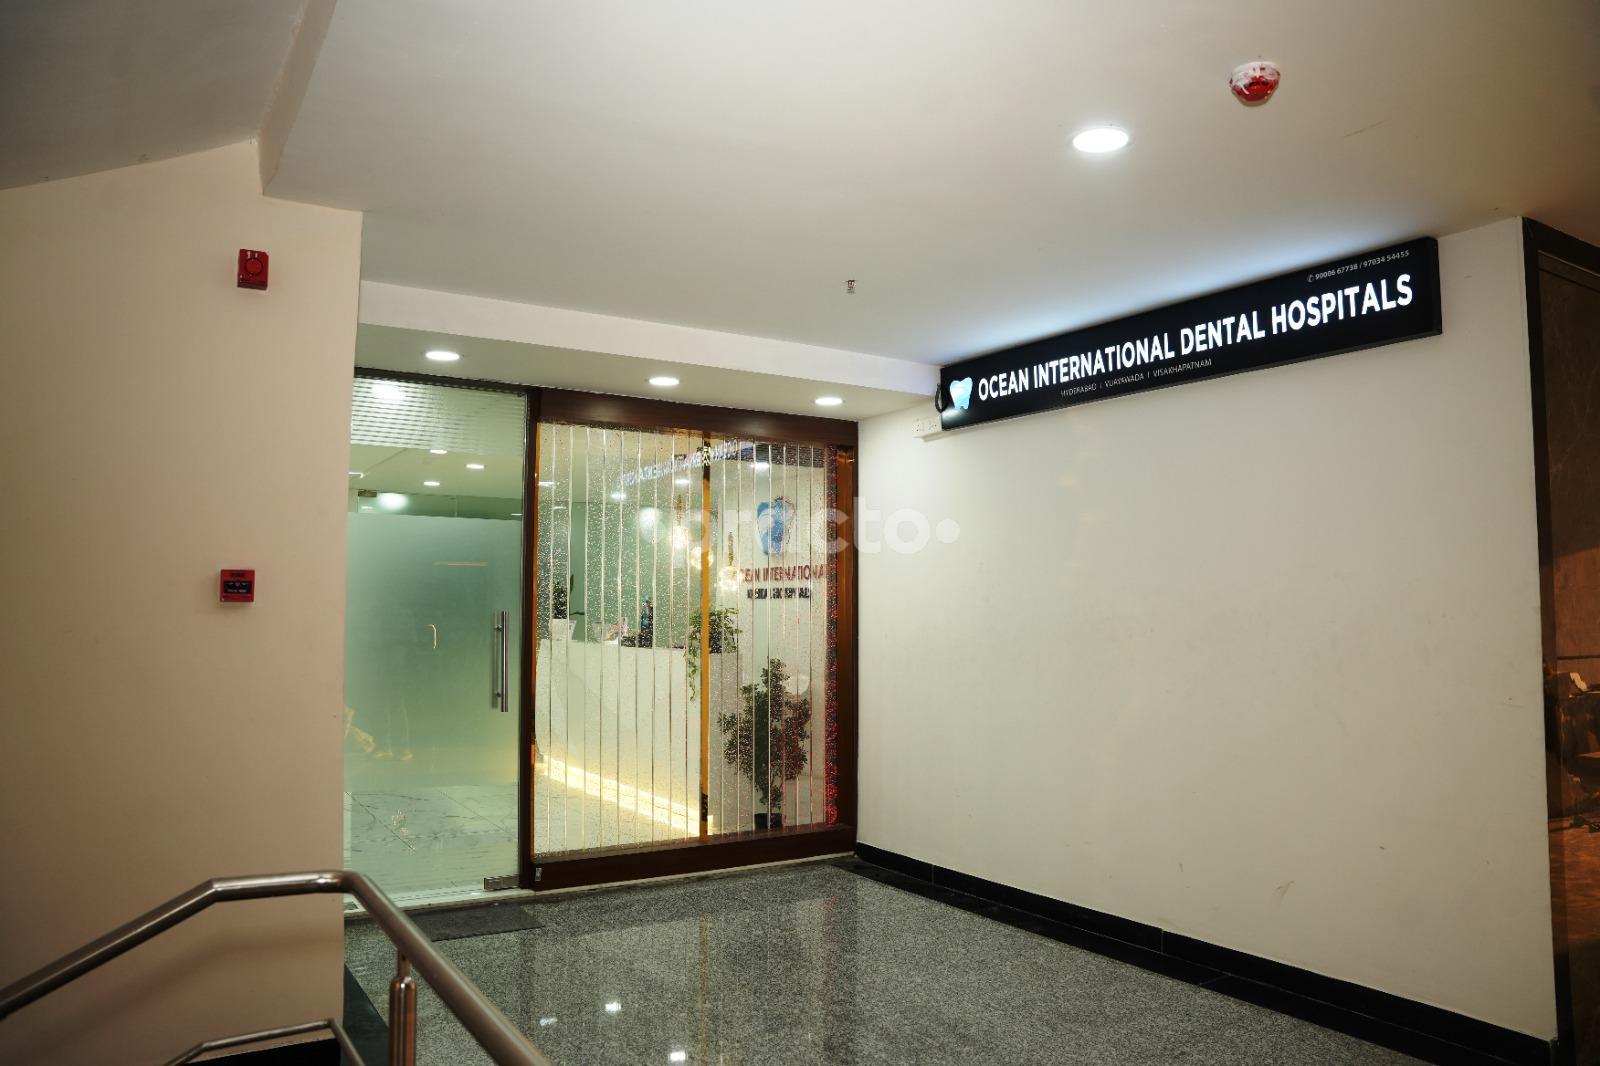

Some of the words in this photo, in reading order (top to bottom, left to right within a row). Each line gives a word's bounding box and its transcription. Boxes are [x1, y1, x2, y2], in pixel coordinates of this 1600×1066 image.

[1315, 270, 1336, 281] 90006
[1336, 263, 1358, 275] 67738
[1386, 249, 1410, 262] 54455
[978, 366, 1030, 401] OCEAN
[1033, 331, 1175, 388] INTERNATIONAL
[1180, 310, 1266, 356] DENTAL
[1271, 273, 1413, 335] HOSPITALS
[1152, 358, 1212, 377] VISAKHAPATNAM
